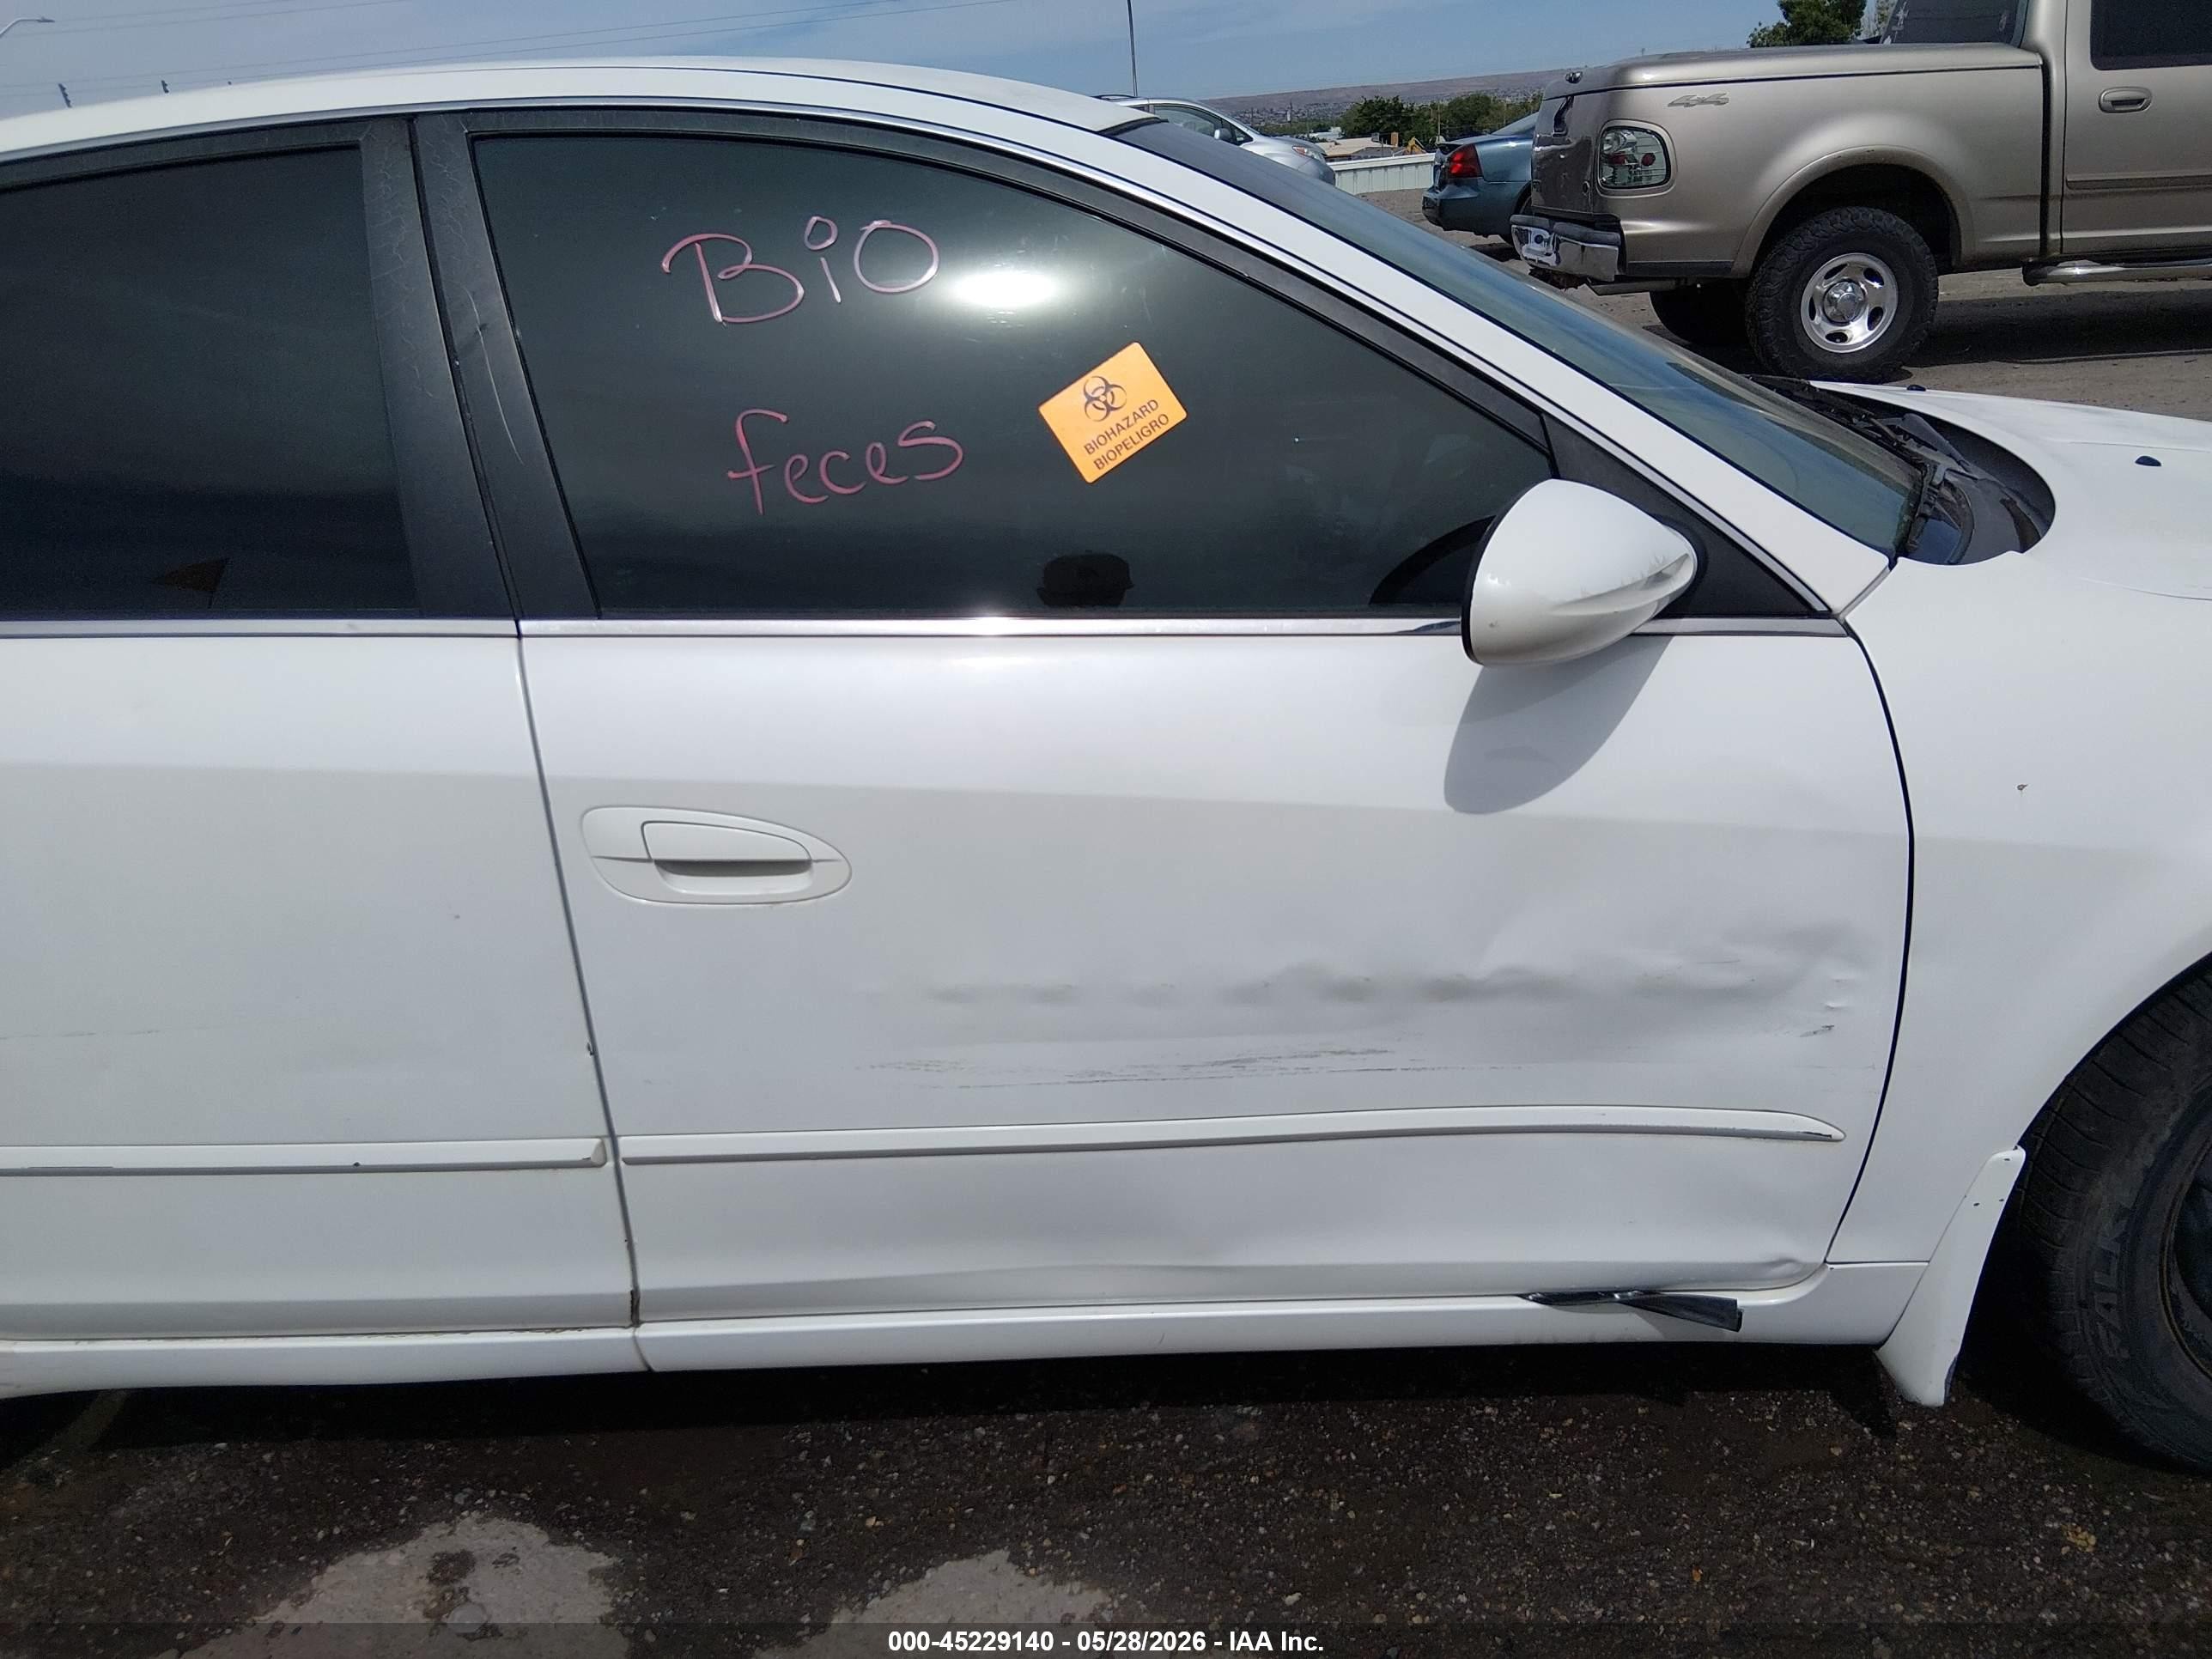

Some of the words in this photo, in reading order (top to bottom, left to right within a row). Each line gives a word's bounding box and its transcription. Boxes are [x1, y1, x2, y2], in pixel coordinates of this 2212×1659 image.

[1084, 399, 1159, 454] BIOHAZARD
[1093, 413, 1169, 470] BIOPELIGRO
[727, 409, 963, 515] feces
